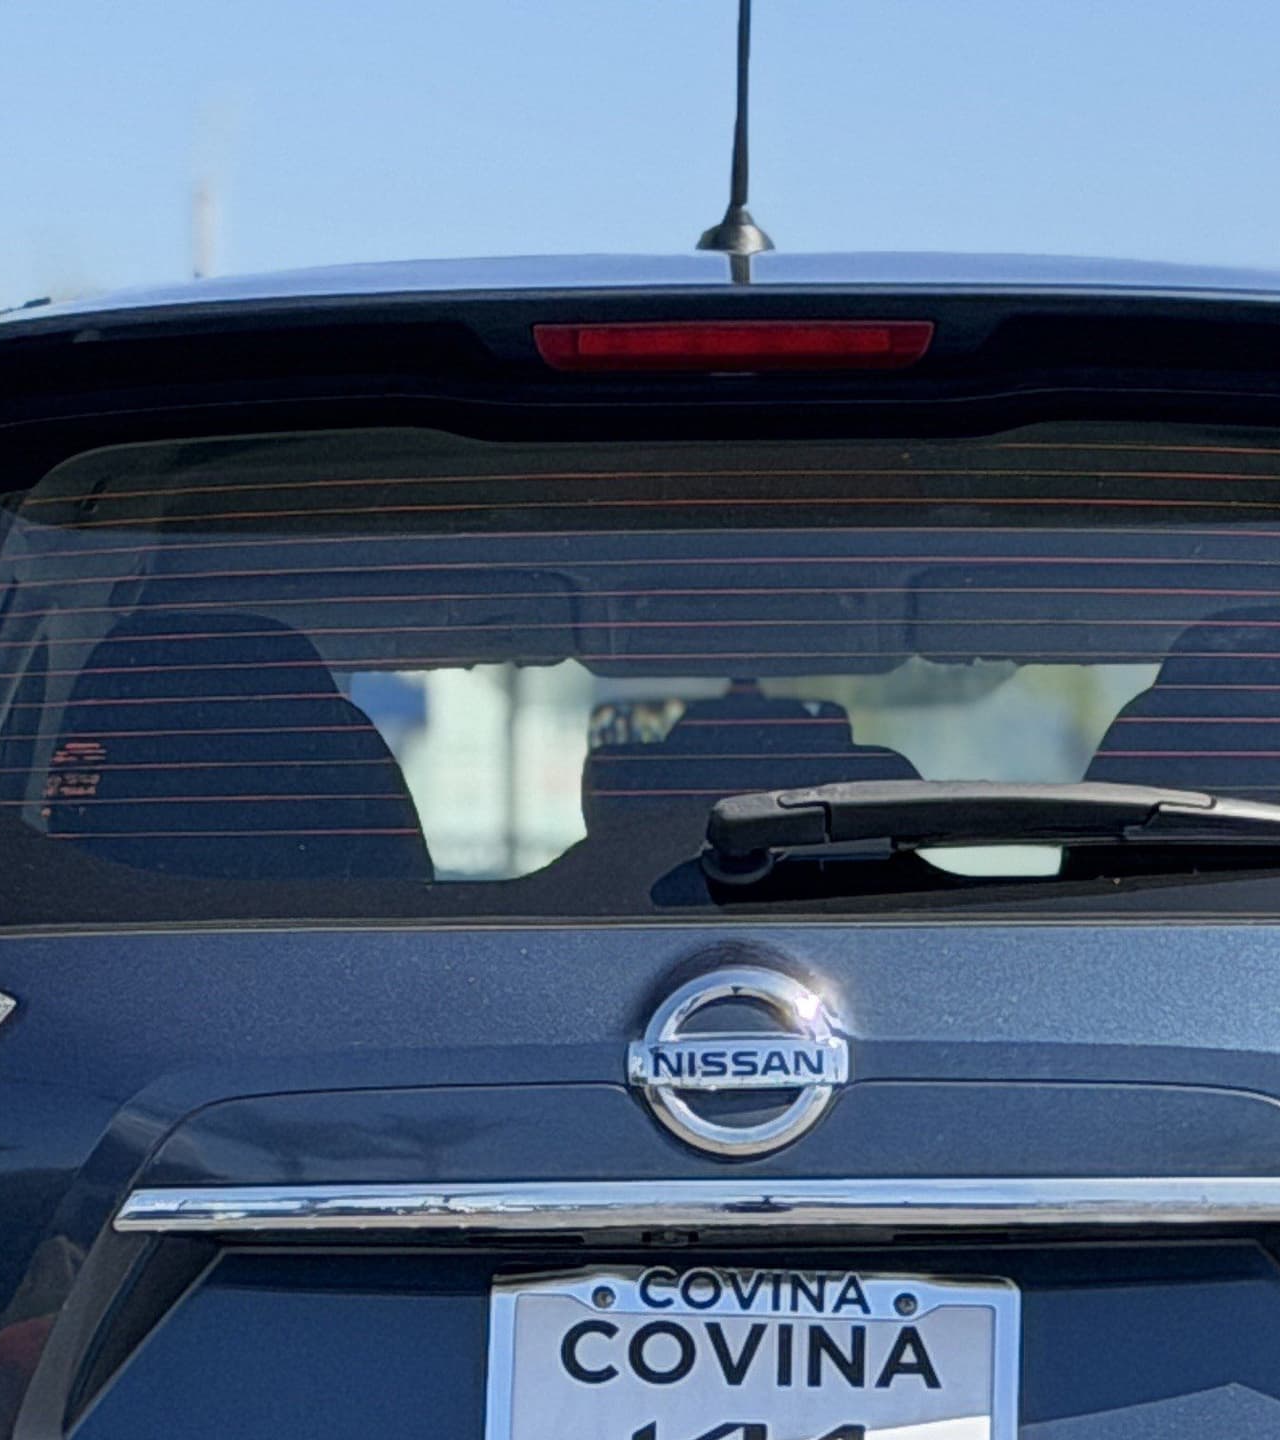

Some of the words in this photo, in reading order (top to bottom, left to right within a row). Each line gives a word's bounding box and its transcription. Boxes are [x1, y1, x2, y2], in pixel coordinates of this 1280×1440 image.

[652, 1050, 824, 1077] NISSAN
[639, 1268, 871, 1314] COVINA
[560, 1320, 942, 1389] COVINA
